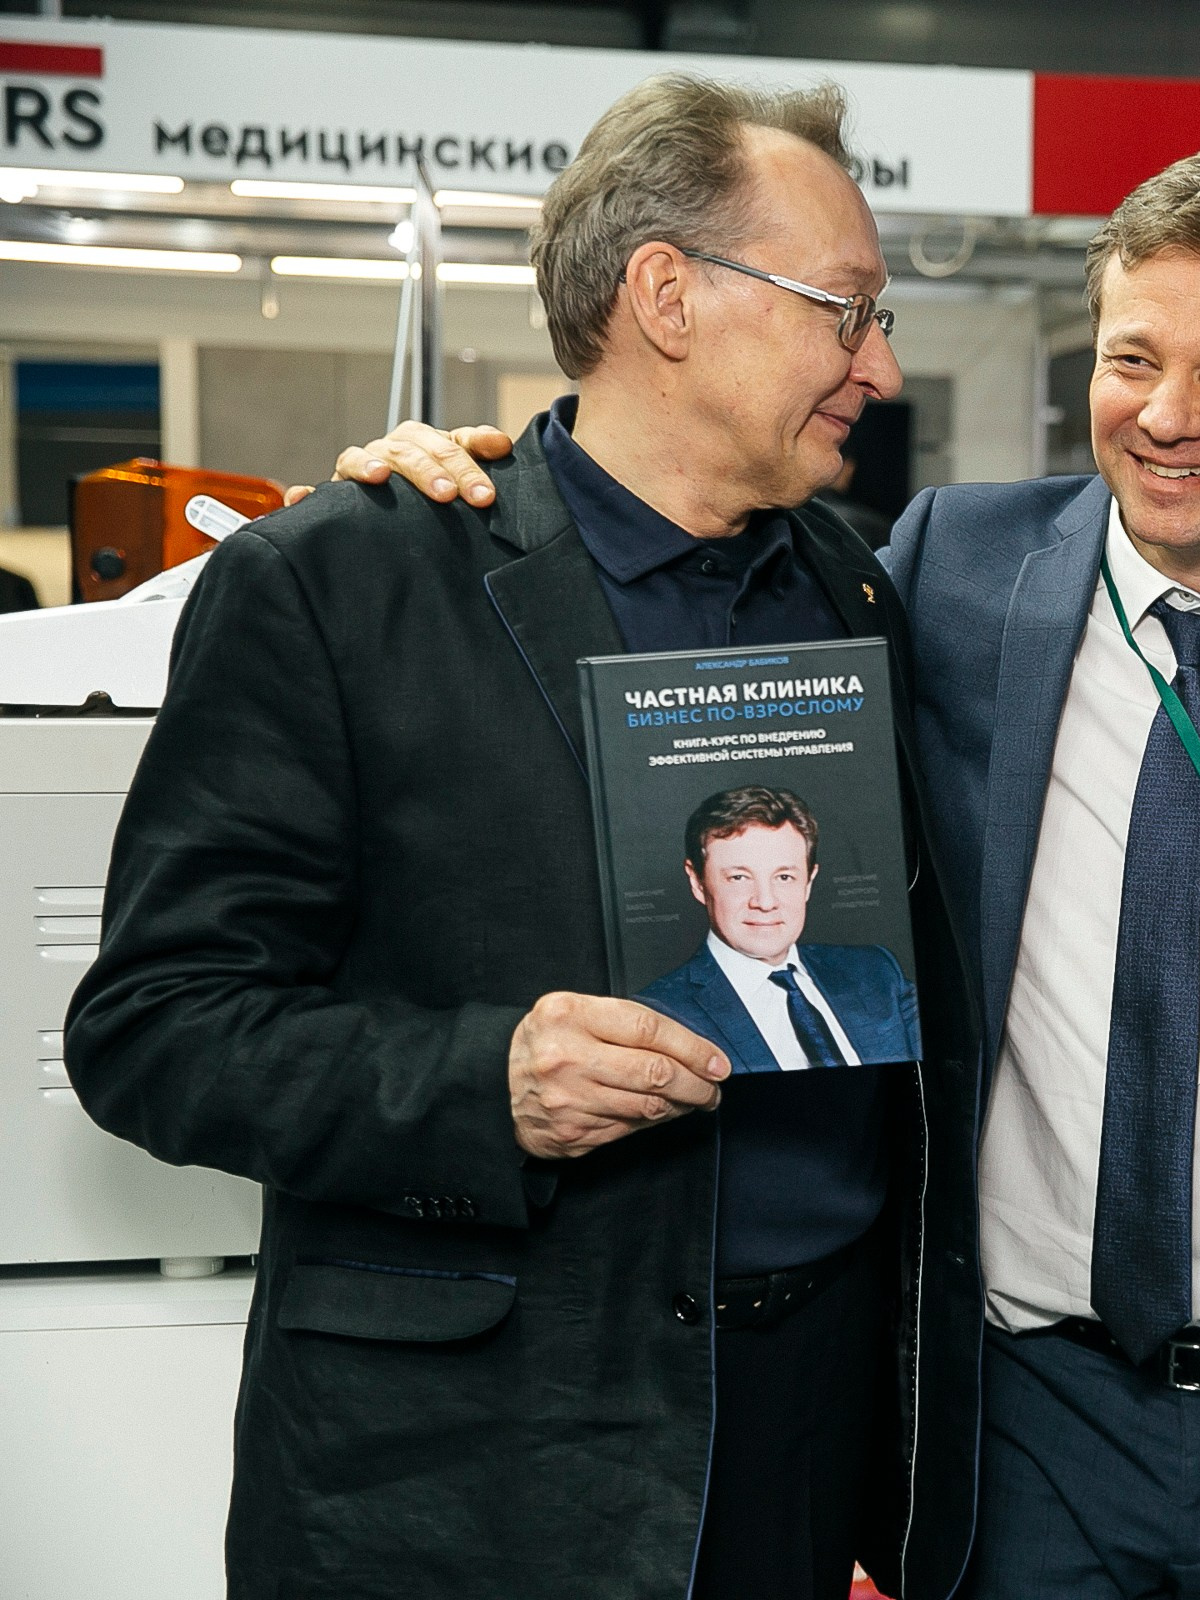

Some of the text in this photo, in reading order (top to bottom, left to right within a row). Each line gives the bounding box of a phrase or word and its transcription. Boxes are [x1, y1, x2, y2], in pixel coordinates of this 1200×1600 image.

[154, 117, 570, 173] медицинские
[624, 675, 865, 709] ЧАСТНАЯ КЛИНИКА
[627, 697, 865, 728] БИЗНЕС ПО-ВЗРОСЛОМУ
[648, 741, 854, 767] ЭФФЕКТИВНОЙ СИСТЕМЫ УПРАВЛЕНИЯ
[673, 728, 827, 749] КНИГА-КУРС ПО ВНЕДРЕНИЮ
